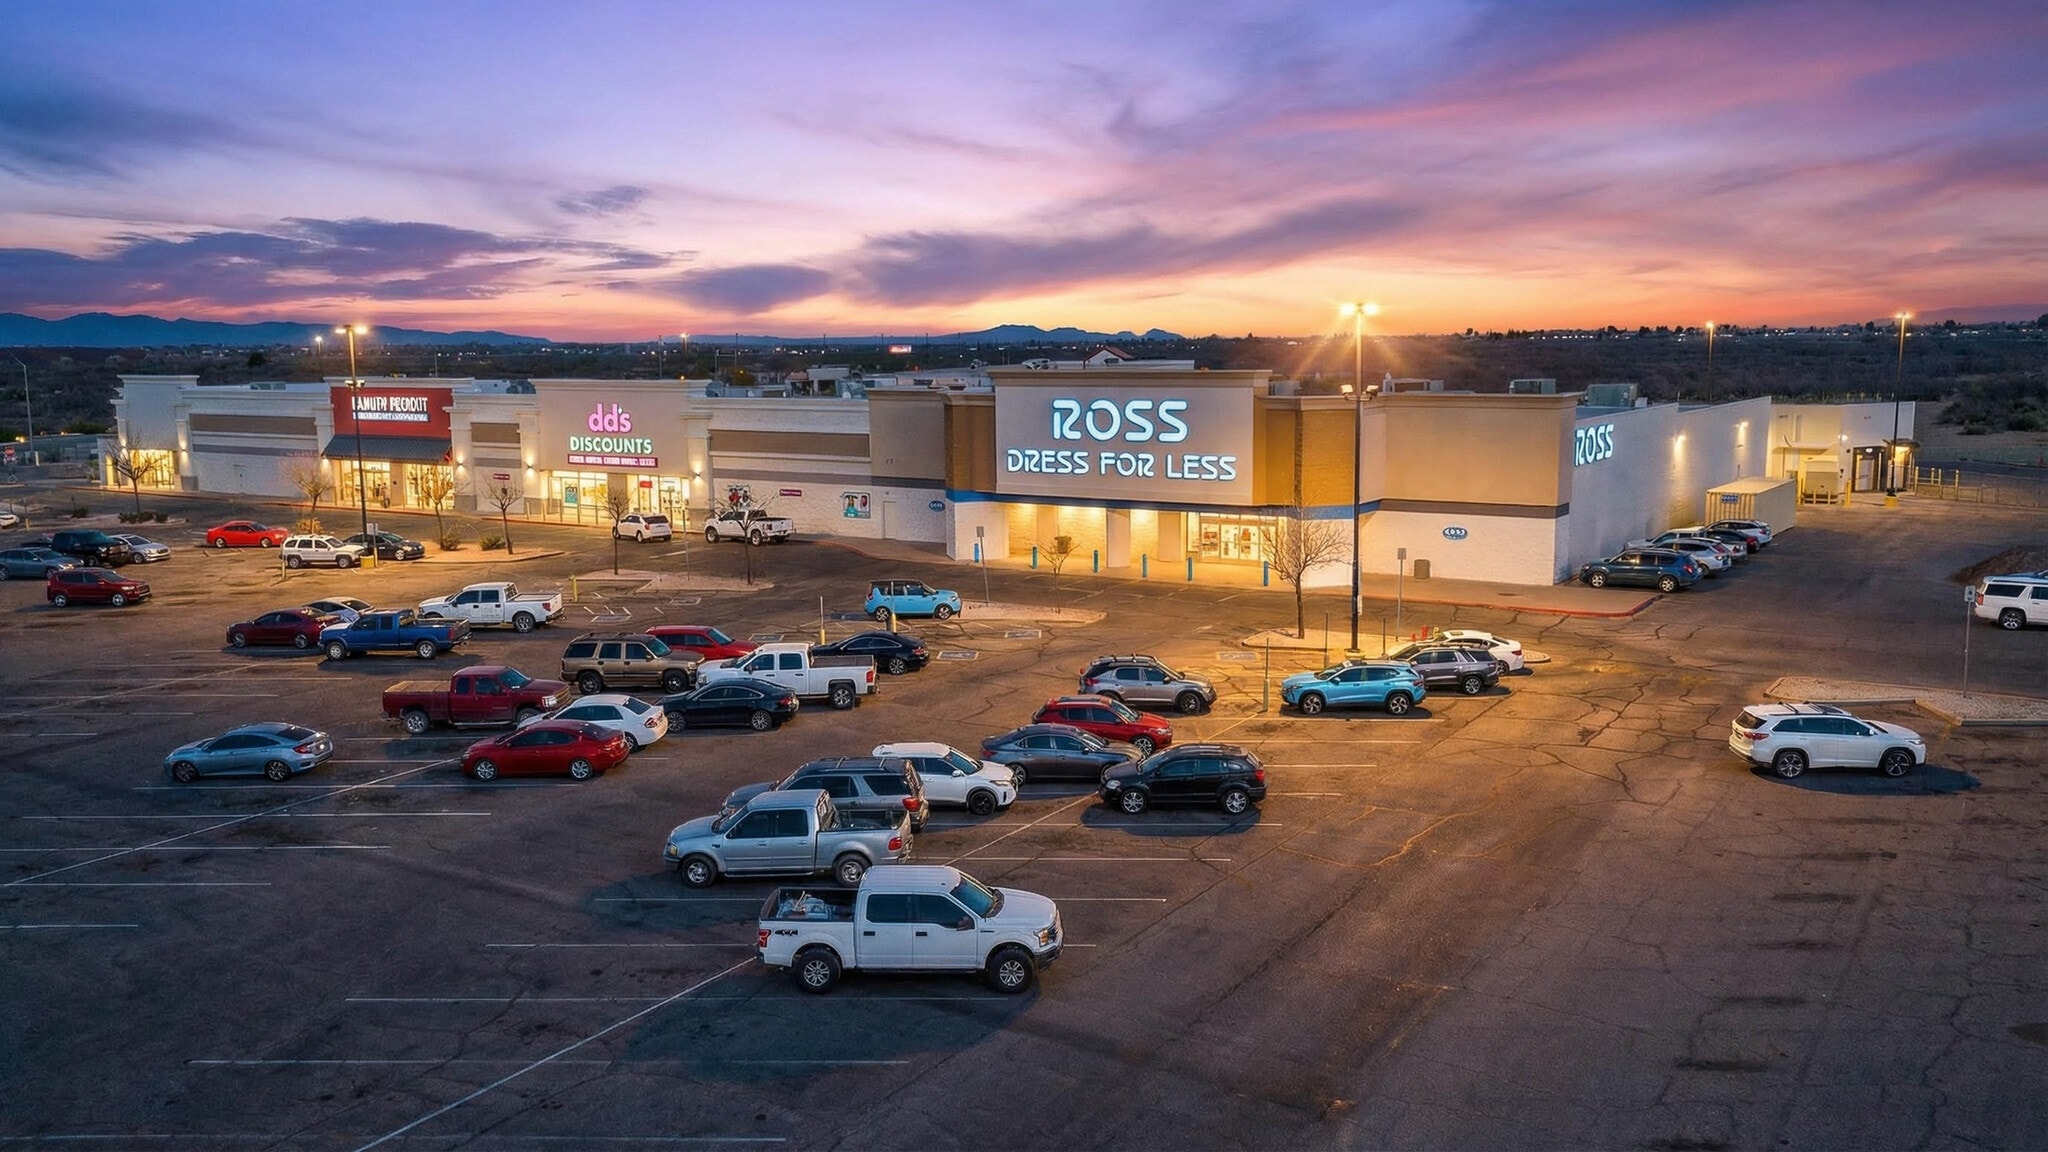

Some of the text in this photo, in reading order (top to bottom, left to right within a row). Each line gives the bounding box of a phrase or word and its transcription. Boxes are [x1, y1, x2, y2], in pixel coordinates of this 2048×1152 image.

[588, 403, 632, 433] dd's
[1052, 399, 1188, 442] ROSS
[569, 436, 653, 454] DISCOUNTS
[1575, 424, 1614, 466] ROSS
[1007, 449, 1237, 481] DRESS FOR LESS
